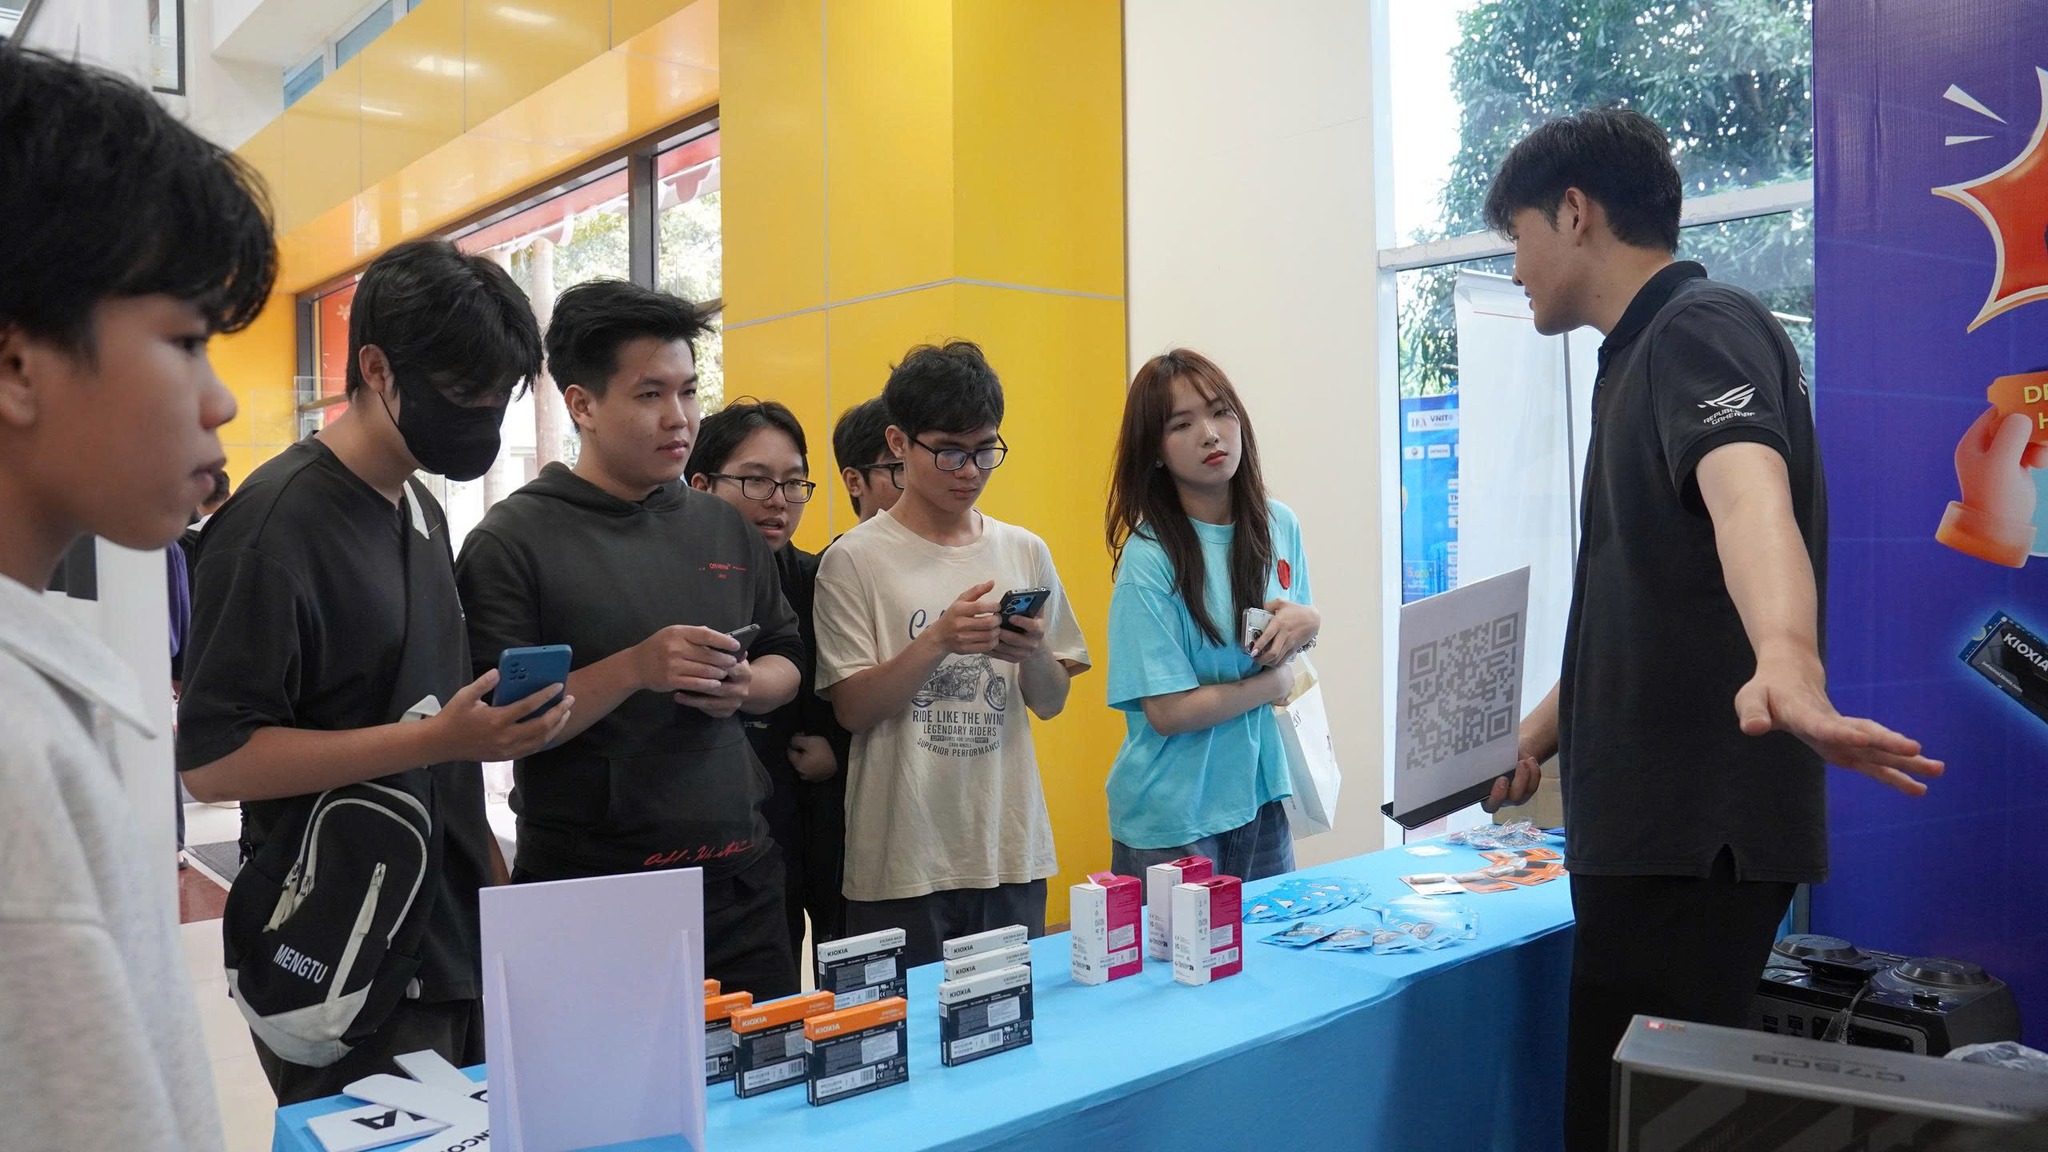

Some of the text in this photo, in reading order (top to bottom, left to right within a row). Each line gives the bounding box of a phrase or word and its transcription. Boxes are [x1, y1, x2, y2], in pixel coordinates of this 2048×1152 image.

[2003, 633, 2048, 672] KIOXIA
[912, 710, 933, 723] RIDE
[937, 710, 959, 723] LIKE
[962, 711, 980, 724] THE
[923, 724, 997, 737] LEGENDARY RIDERS
[916, 737, 949, 756] SUPERIOR
[827, 948, 848, 957] KIOXIA
[953, 944, 974, 954] KIOXIA
[273, 943, 329, 984] MENGTU
[955, 965, 976, 975] KIOXIA
[949, 988, 971, 998] KIOXIA
[741, 1016, 767, 1027] KIOXIA
[815, 1023, 840, 1034] KIOXIA
